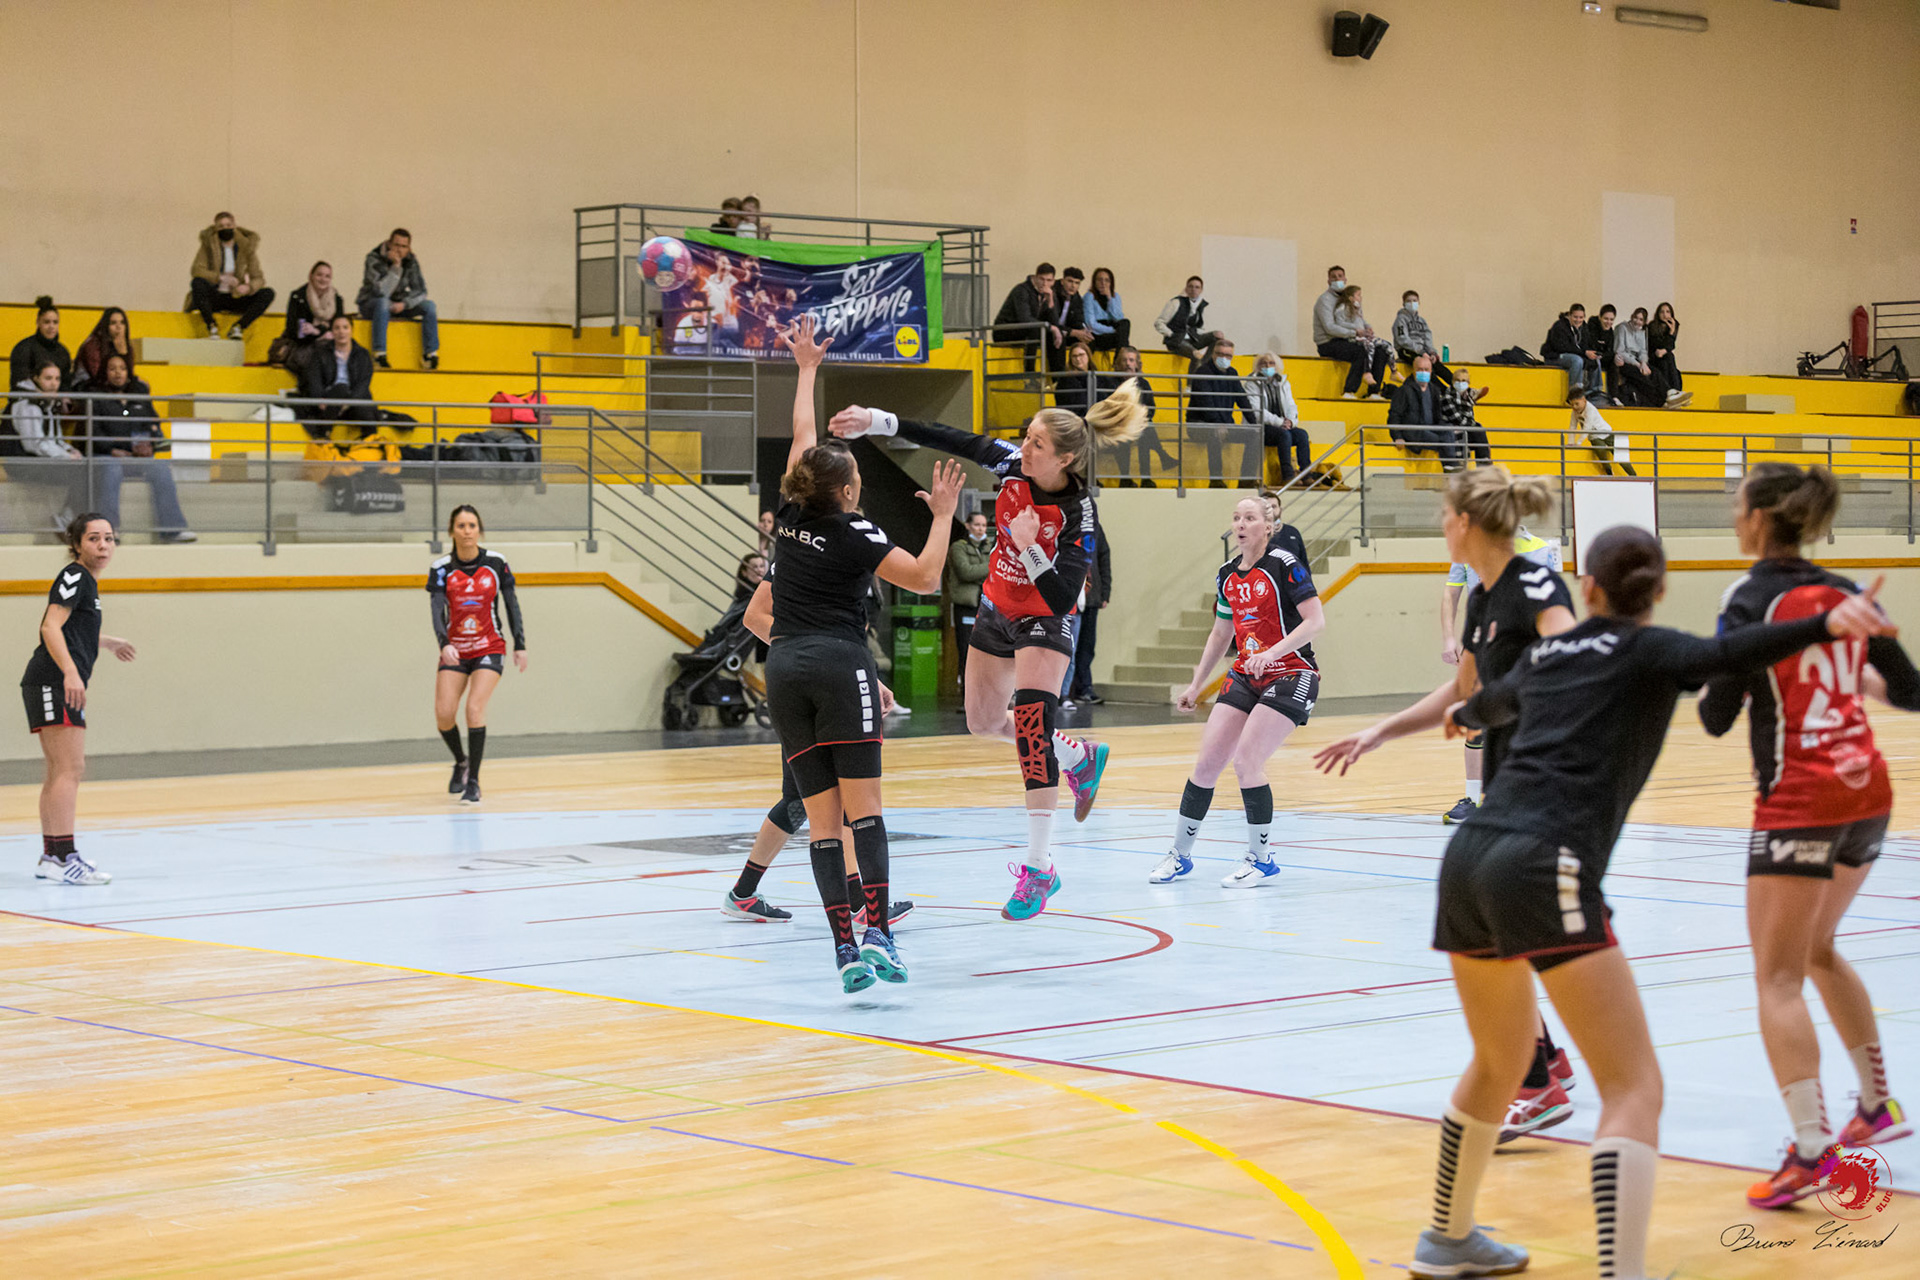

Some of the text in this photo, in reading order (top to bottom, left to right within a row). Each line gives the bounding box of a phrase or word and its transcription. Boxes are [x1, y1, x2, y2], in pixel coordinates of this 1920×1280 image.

[897, 336, 918, 345] LIDL
[464, 578, 474, 593] 2
[1236, 582, 1251, 603] 33
[1797, 638, 1862, 732] 24
